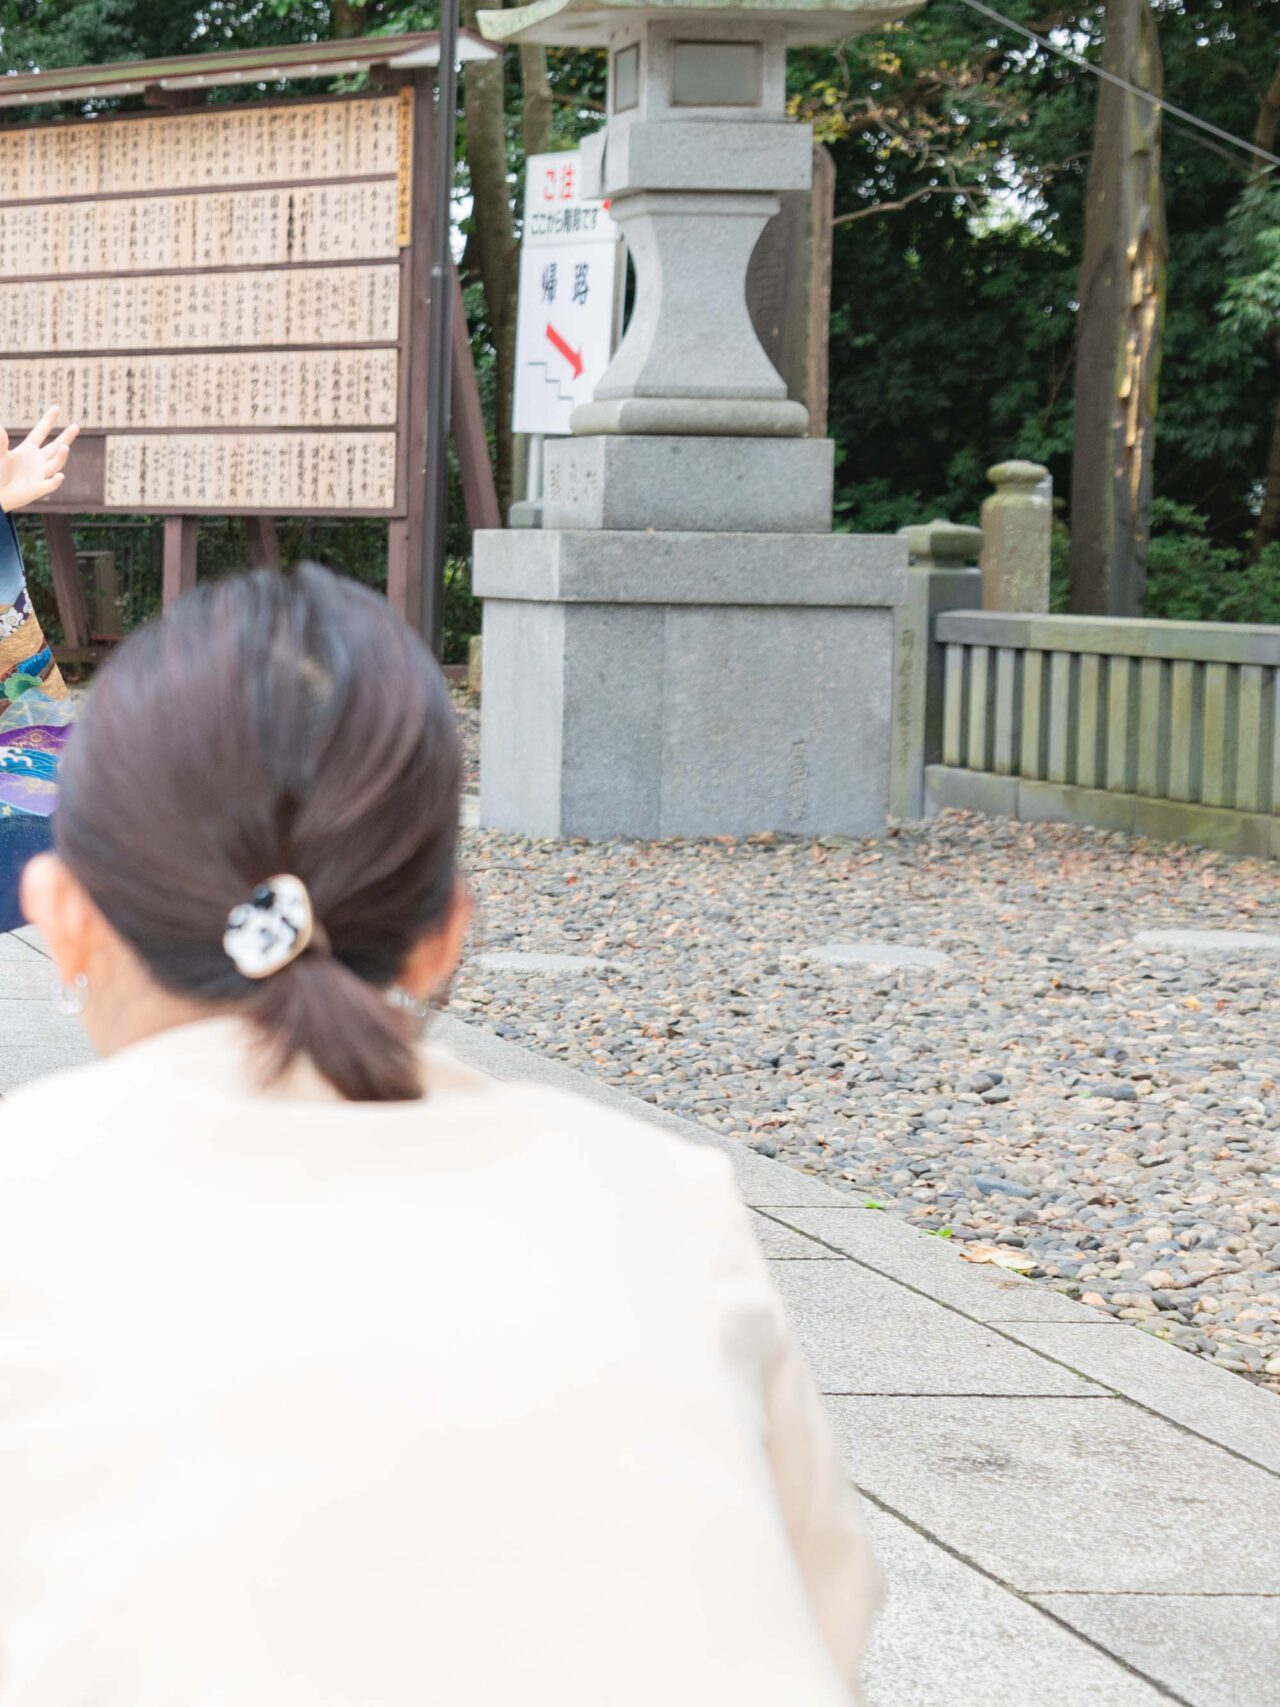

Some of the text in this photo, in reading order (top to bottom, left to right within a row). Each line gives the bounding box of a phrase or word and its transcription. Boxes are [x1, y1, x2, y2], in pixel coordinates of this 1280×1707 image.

[530, 208, 600, 235] ここから階段です
[542, 263, 591, 306] 帰路
